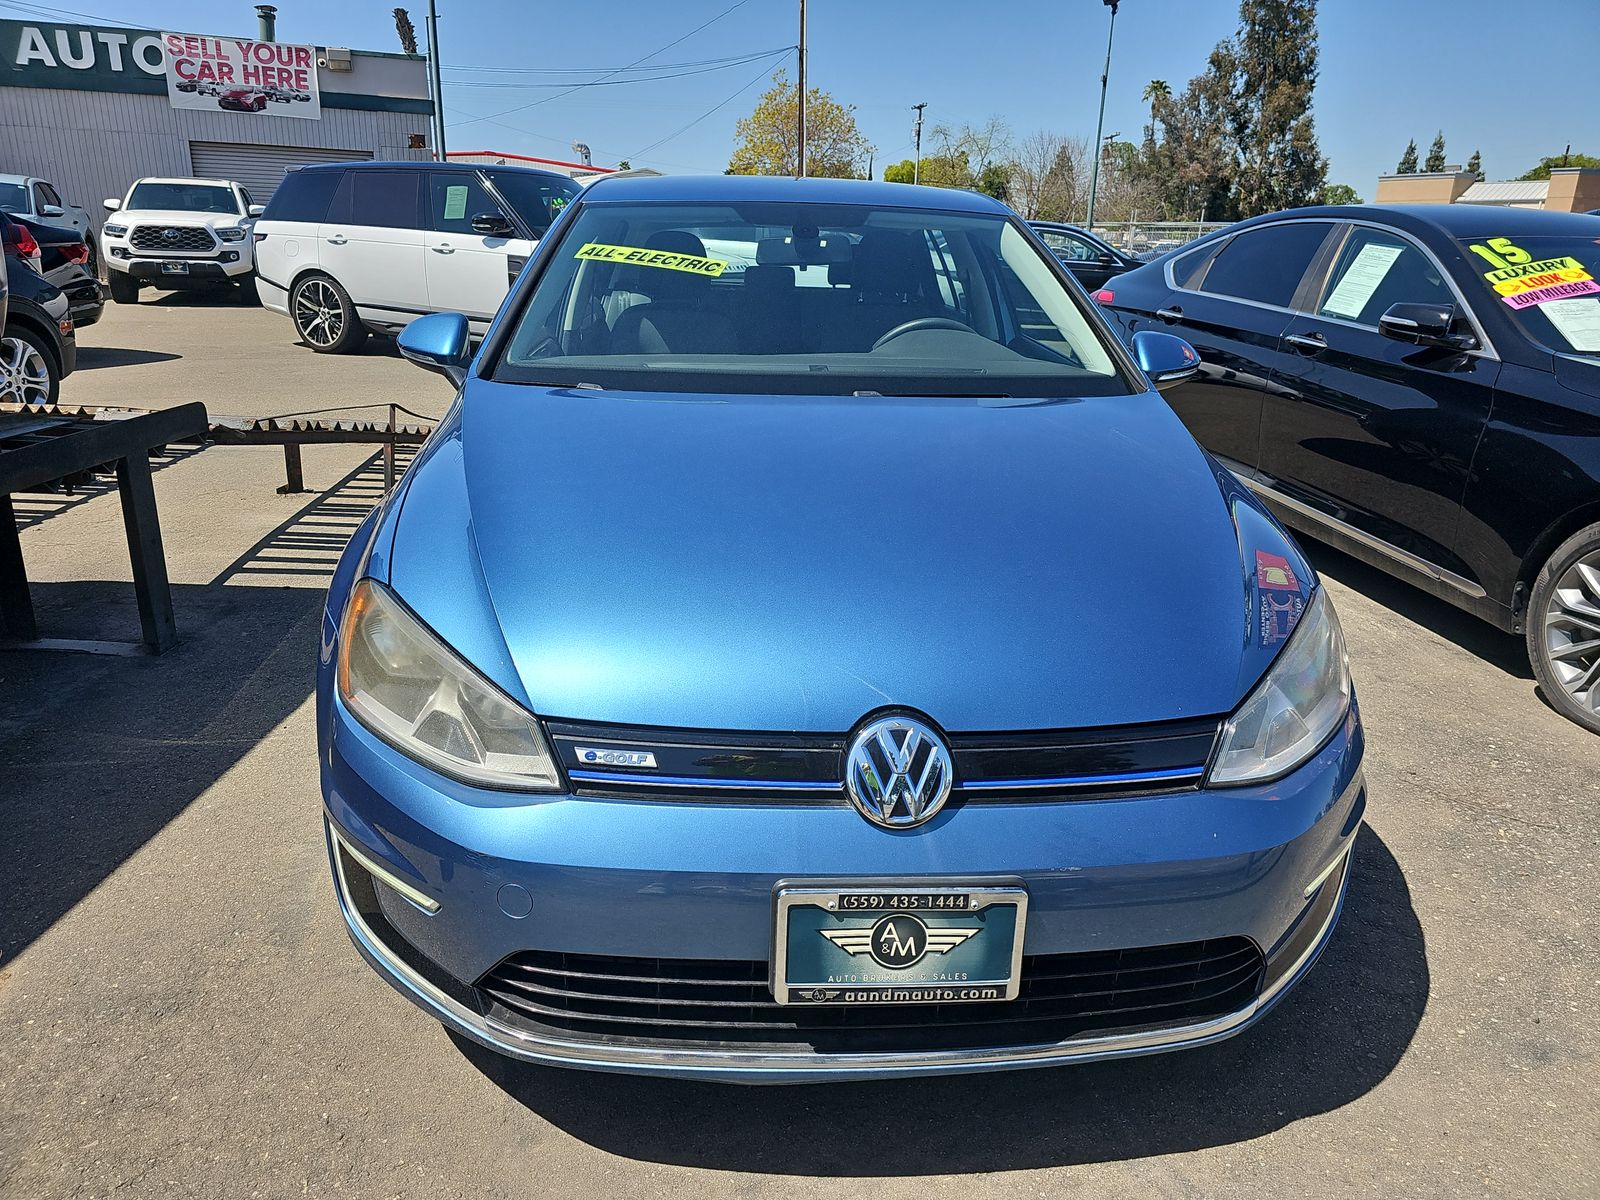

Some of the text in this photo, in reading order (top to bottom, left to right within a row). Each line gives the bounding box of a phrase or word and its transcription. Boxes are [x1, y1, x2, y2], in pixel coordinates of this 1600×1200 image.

[16, 26, 167, 75] AUTO
[167, 35, 312, 69] SELL YOUR
[175, 58, 310, 91] CAR HERE
[580, 246, 722, 273] ALL-ELECTRIC
[1469, 237, 1532, 269] 15
[1492, 259, 1568, 282] LUXURY
[1519, 272, 1567, 288] LOOK
[1511, 281, 1594, 306] LOW MILEAGE
[843, 896, 964, 908] (559) 435-1444
[827, 974, 857, 983] AUTO
[933, 972, 968, 981] SALES
[844, 988, 998, 1002] aandmauto.com
